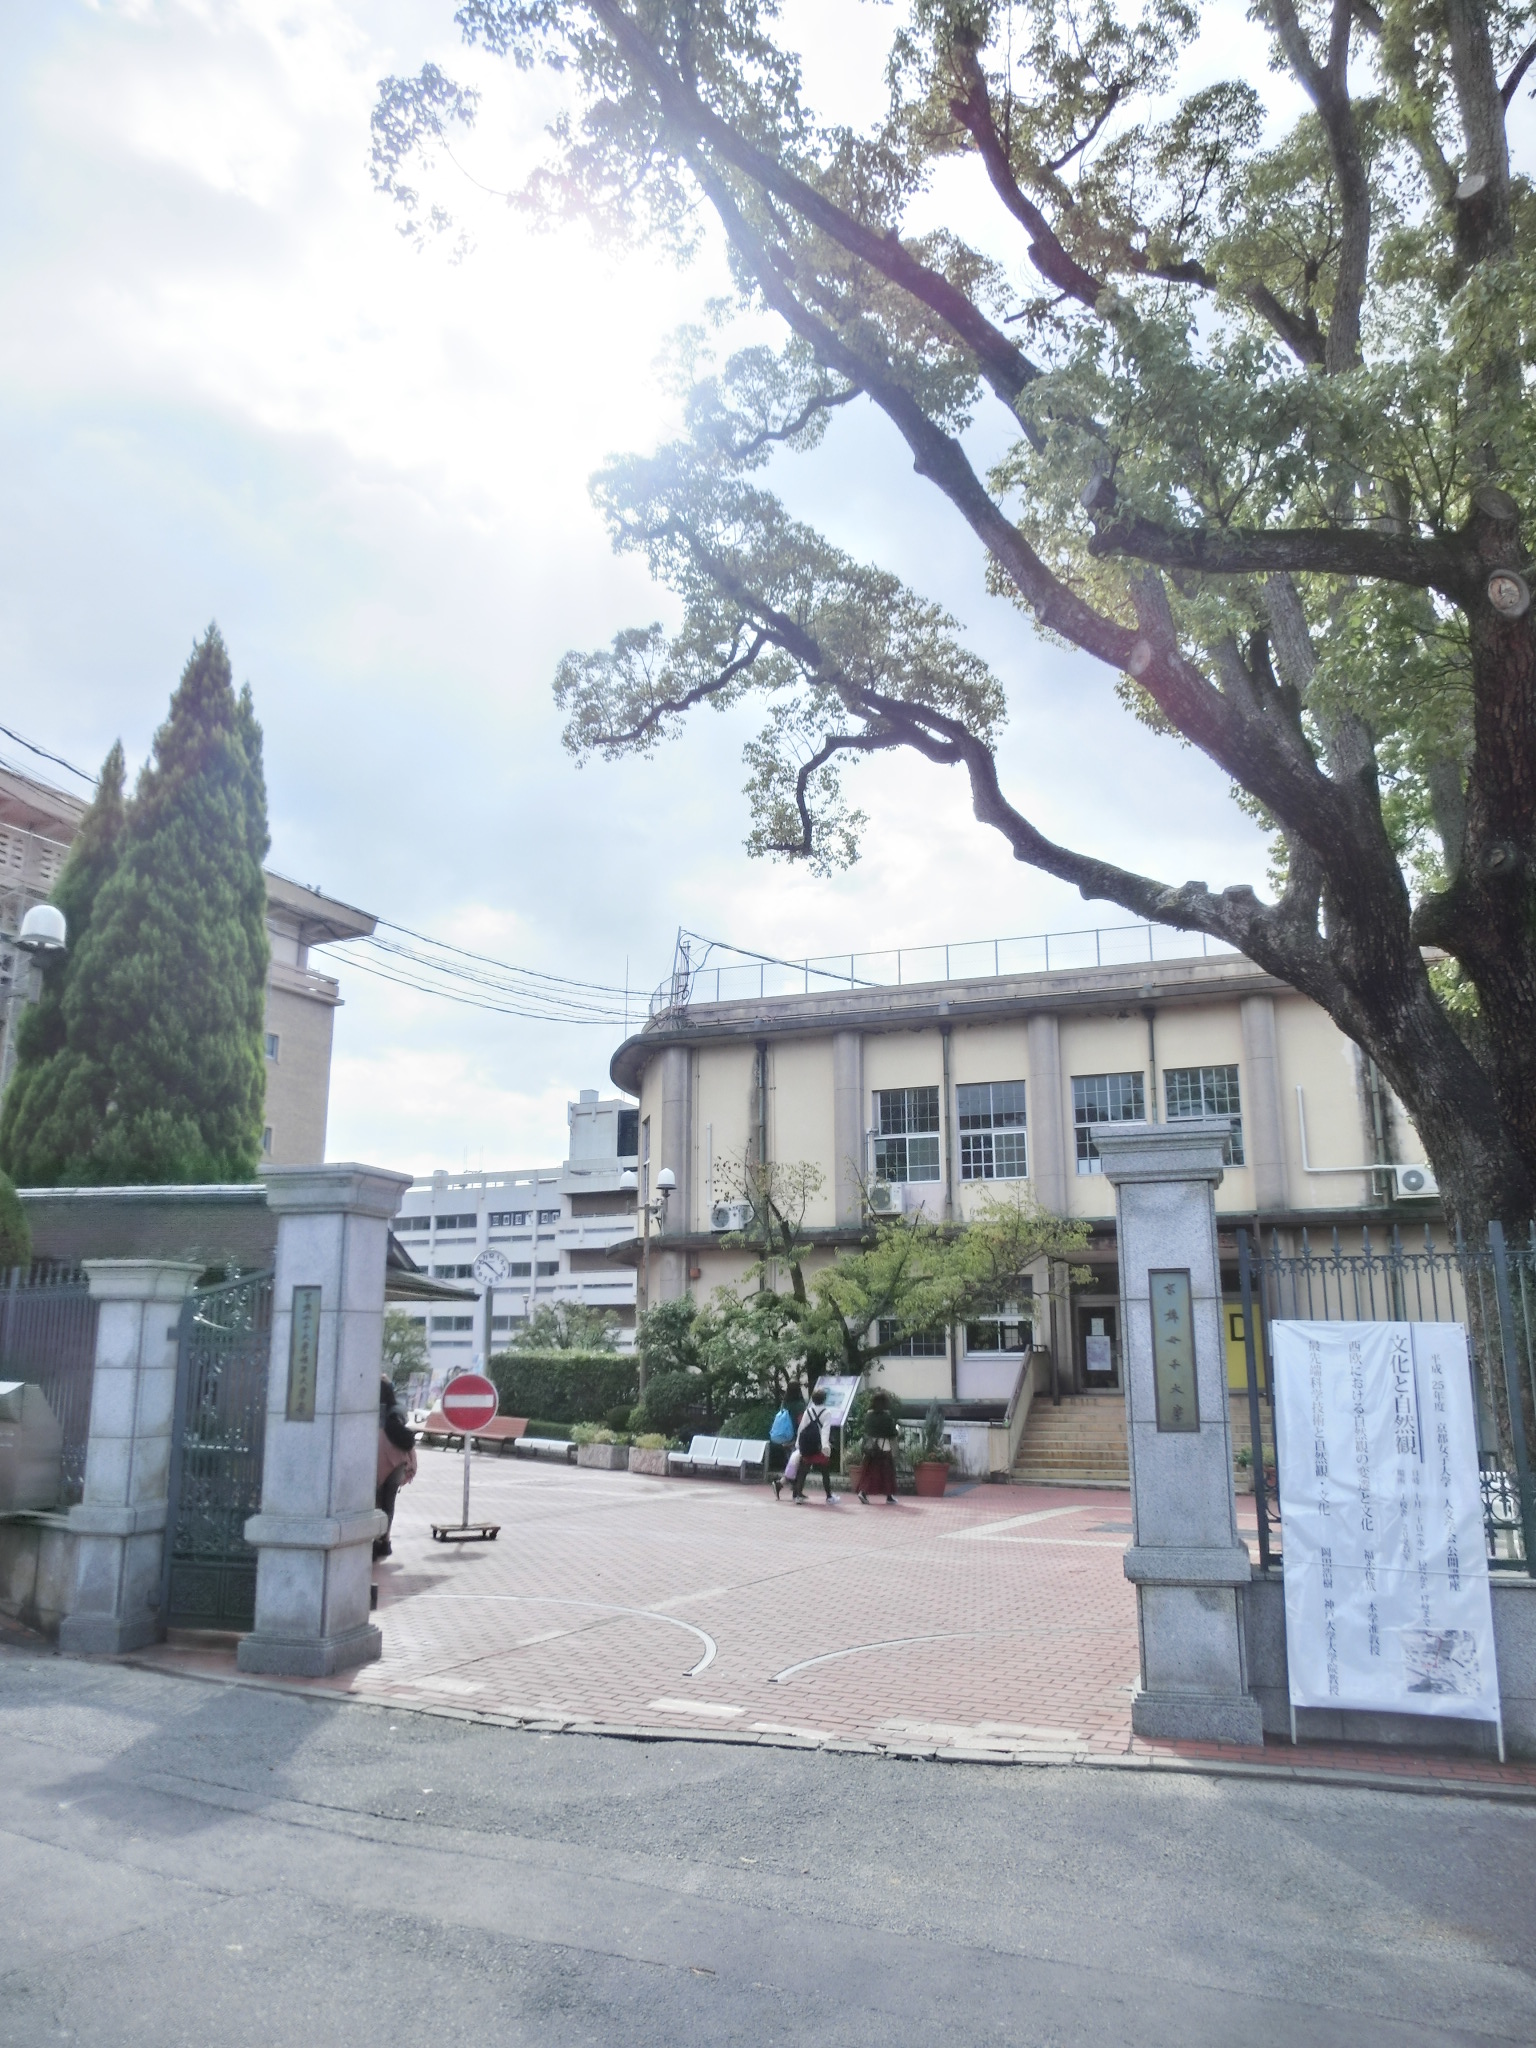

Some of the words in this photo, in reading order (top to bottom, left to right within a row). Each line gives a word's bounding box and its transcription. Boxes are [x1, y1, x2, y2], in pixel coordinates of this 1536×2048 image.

[1431, 1353, 1443, 1375] 平成
[1390, 1334, 1417, 1456] 文化と自然観
[1432, 1381, 1446, 1412] 25年度
[1437, 1422, 1452, 1488] 京都女子大学
